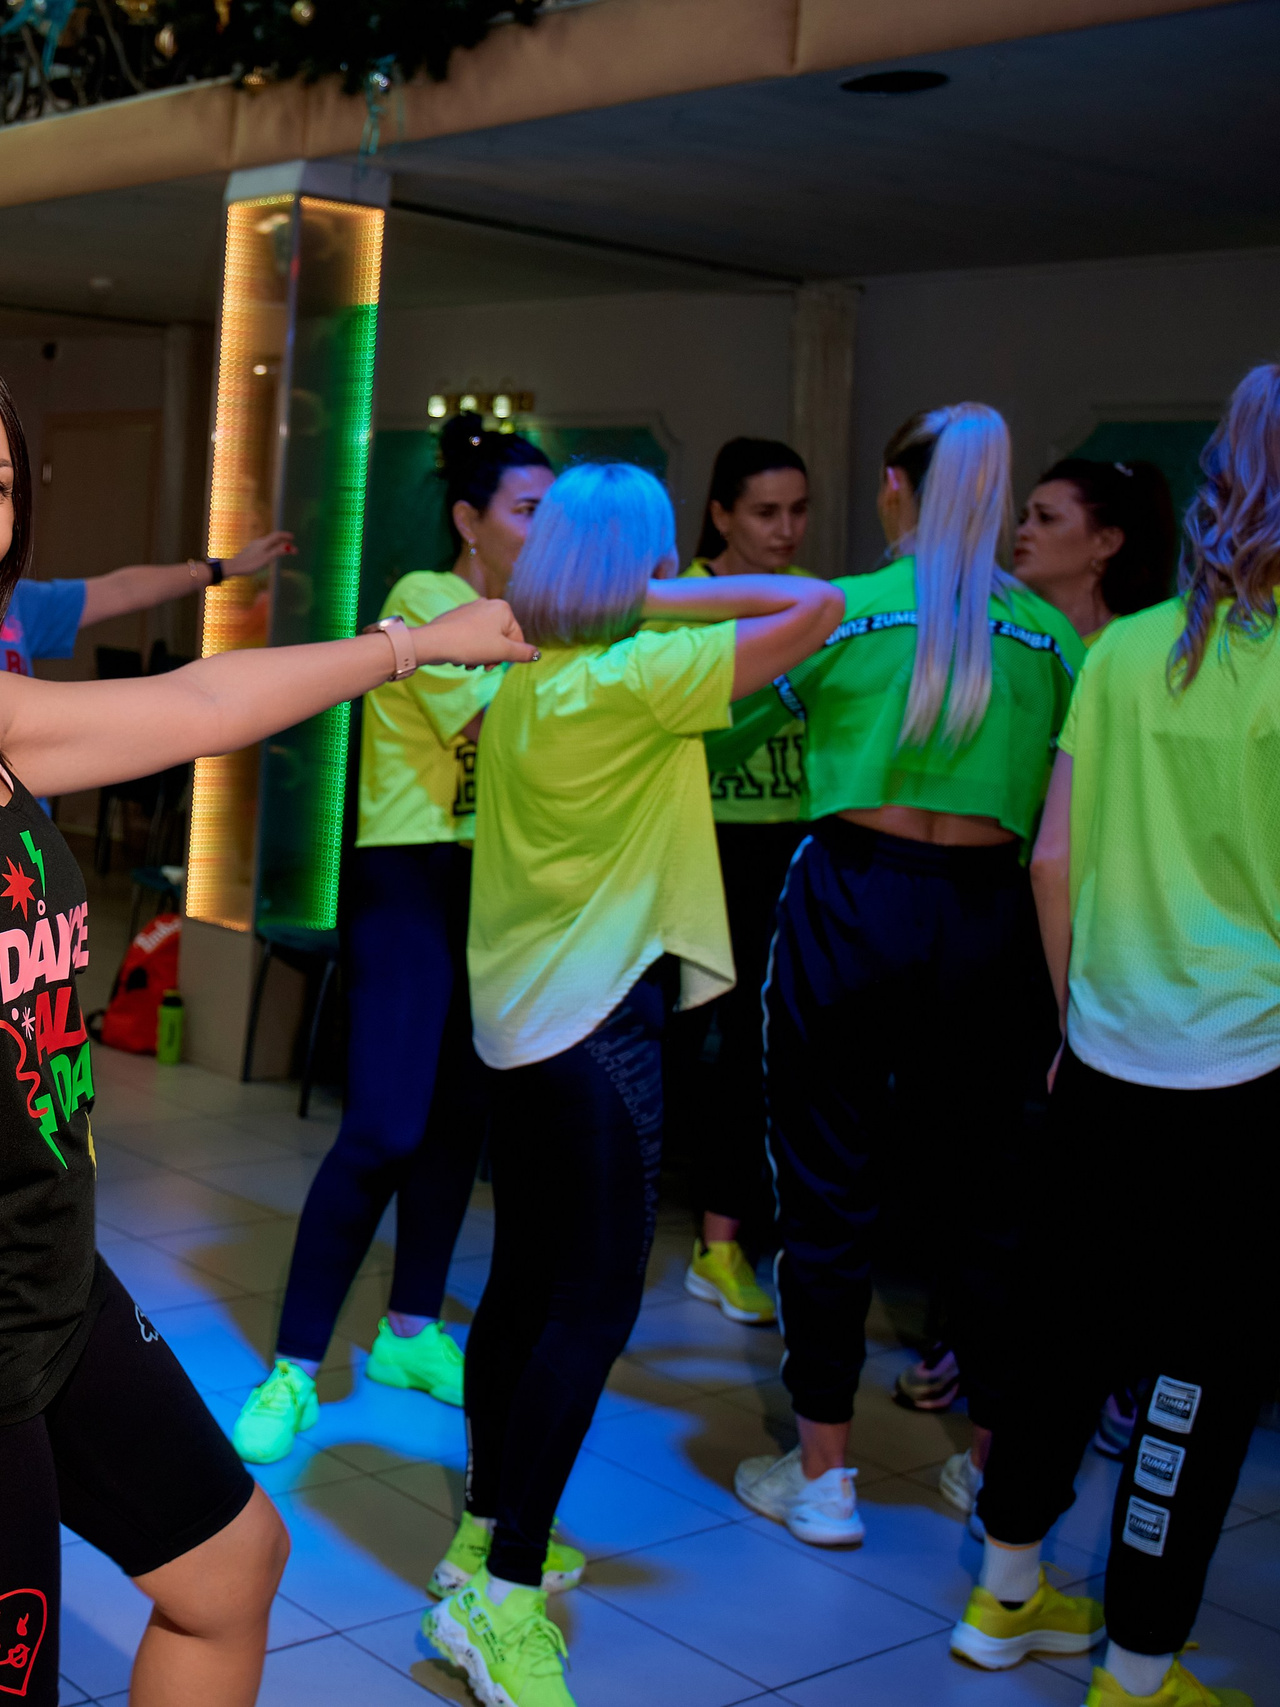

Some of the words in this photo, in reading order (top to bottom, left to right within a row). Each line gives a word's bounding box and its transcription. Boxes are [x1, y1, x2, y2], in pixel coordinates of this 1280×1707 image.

[1156, 1392, 1191, 1412] ZUMBA
[1141, 1454, 1174, 1473] ZUMBA
[1130, 1514, 1161, 1535] ZUMBA
